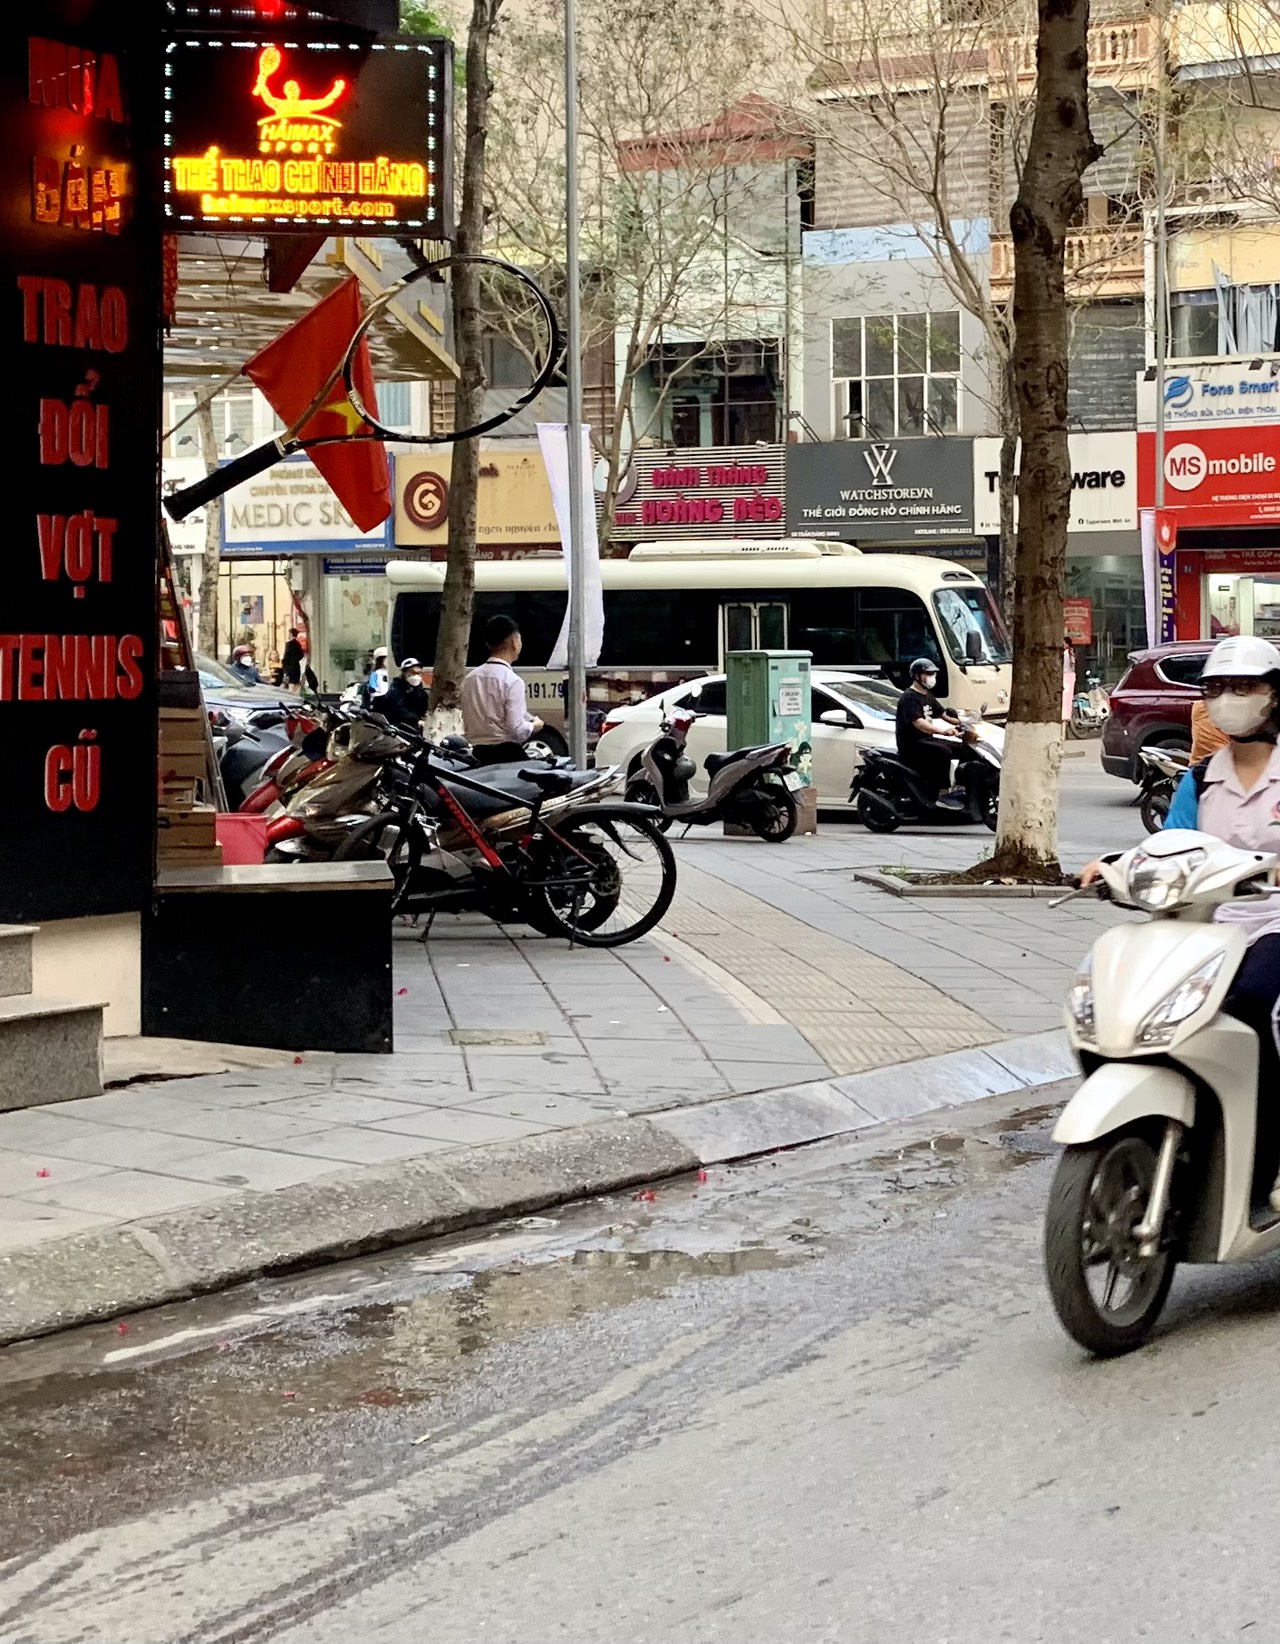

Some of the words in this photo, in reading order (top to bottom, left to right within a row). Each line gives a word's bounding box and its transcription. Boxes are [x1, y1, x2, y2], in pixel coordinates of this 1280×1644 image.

[259, 141, 336, 154] SPORT
[221, 159, 280, 193] THAO
[18, 276, 128, 353] TRAO
[1201, 383, 1234, 397] Fone
[1239, 380, 1279, 394] Smart
[39, 369, 109, 469] ĐỔI
[1169, 456, 1202, 477] MS
[1208, 452, 1276, 475] mobile
[231, 502, 313, 530] MEDIC
[825, 505, 846, 518] GIỚI
[899, 503, 931, 515] CHÍNH
[932, 503, 962, 515] HÃNG
[36, 509, 119, 598] VỢT
[0, 634, 144, 701] TENNIS
[44, 729, 101, 812] CŨ
